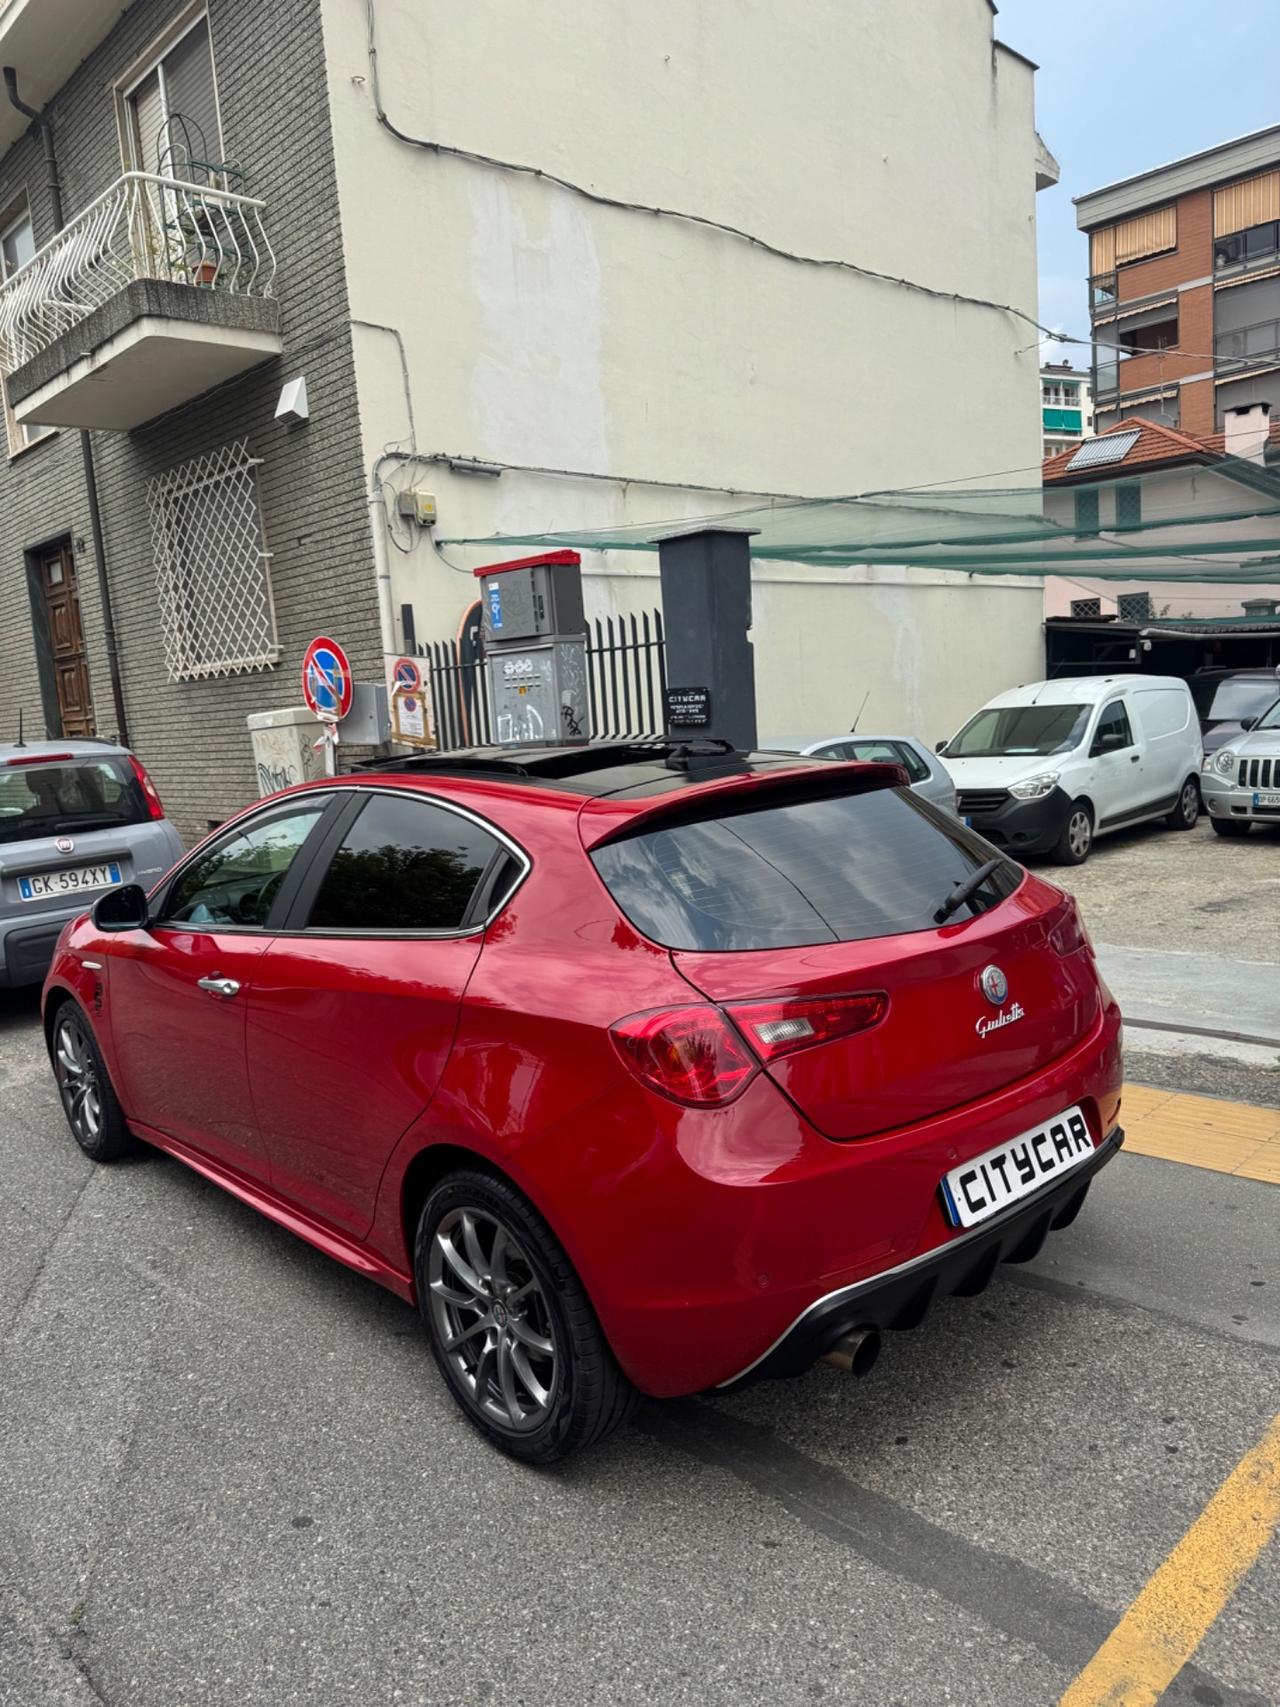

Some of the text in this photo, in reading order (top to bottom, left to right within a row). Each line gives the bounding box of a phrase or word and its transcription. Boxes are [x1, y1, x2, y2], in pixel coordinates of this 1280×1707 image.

[668, 694, 706, 703] CITYCAR
[31, 866, 109, 894] GK 594XY
[975, 1002, 1025, 1039] Giulietta
[959, 1113, 1091, 1214] CITYCAR
